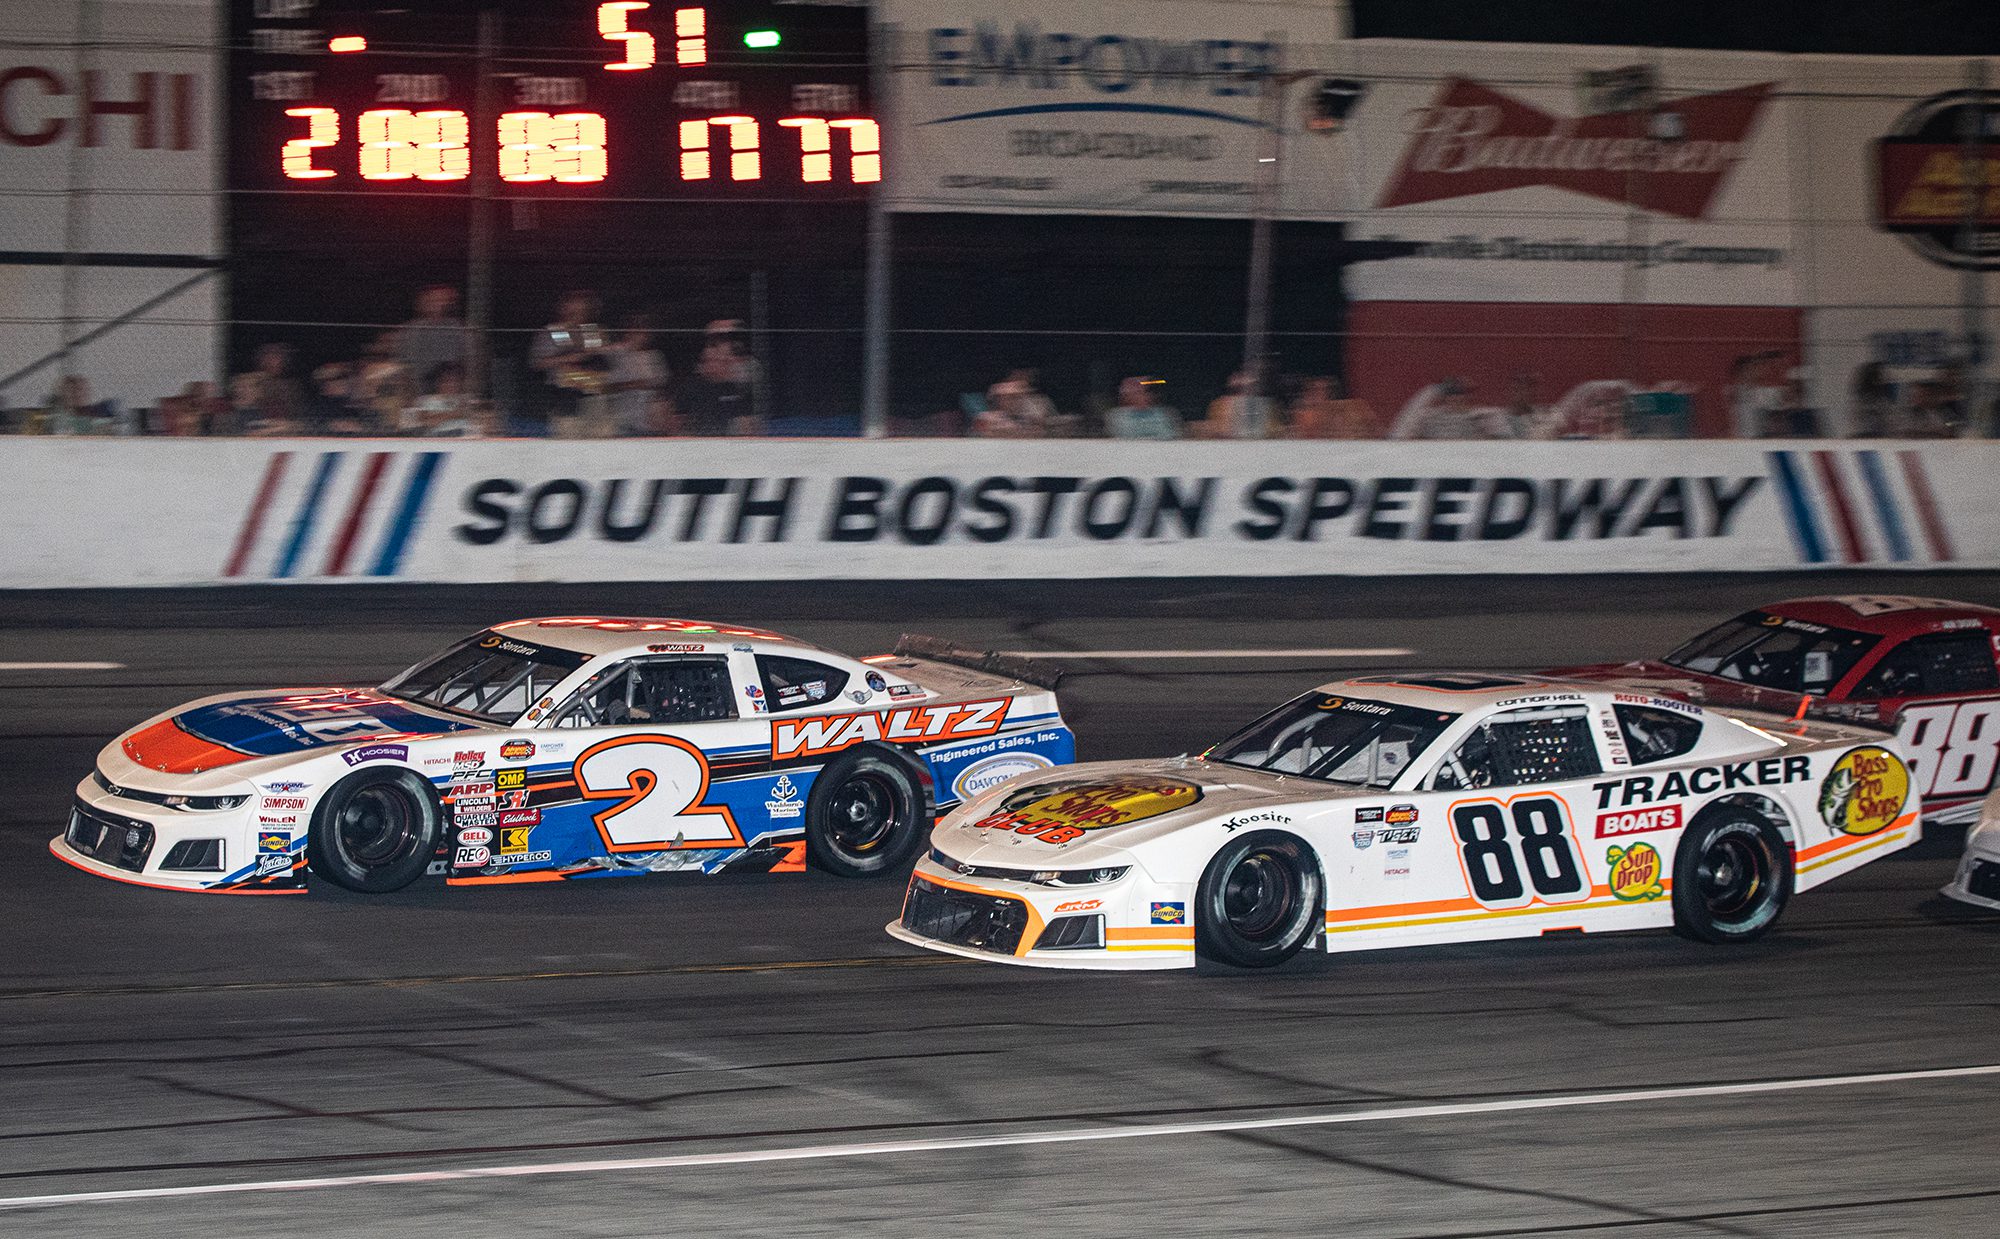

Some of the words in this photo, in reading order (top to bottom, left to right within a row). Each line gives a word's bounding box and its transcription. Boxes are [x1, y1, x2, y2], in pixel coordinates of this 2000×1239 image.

[281, 107, 340, 179] 2
[1407, 104, 1747, 173] Budweiser
[456, 477, 800, 544] SOUTH
[825, 476, 1216, 544] BOSTON
[1236, 475, 1765, 541] SPEEDWAY
[499, 641, 536, 655] Sentara
[1496, 695, 1550, 706] CONNOR
[1342, 701, 1391, 715] Sentara
[771, 696, 1013, 760] WALTZ
[361, 748, 405, 757] HOOSIER
[930, 741, 995, 763] Engineered
[998, 734, 1035, 750] Sales,
[1037, 732, 1060, 743] Inc.
[1896, 700, 2000, 796] 88
[454, 751, 486, 763] Holley
[454, 761, 483, 770] MSD
[1853, 754, 1888, 778] Bass
[451, 769, 493, 780] PFC
[498, 774, 524, 786] OMP
[1593, 755, 1810, 808] TRACKER
[450, 783, 494, 796] ARP
[575, 734, 748, 852] 2
[1855, 777, 1882, 799] Pro
[264, 798, 305, 809] SIMPSON
[457, 797, 489, 806] LINCOLN
[1855, 796, 1899, 821] Shops
[259, 815, 296, 823] WHELEN
[455, 813, 494, 824] QUARTER
[462, 819, 497, 827] MASTER
[503, 811, 538, 824] Edelbrock
[1221, 811, 1291, 833] Hoosier
[1603, 808, 1677, 835] BOATS
[973, 812, 1087, 844] CLUB
[260, 839, 290, 847] SUNOCO
[463, 832, 487, 840] BELL
[1452, 797, 1583, 902] 88
[503, 852, 549, 863] HYPERCO
[1621, 848, 1655, 870] Sun
[256, 855, 292, 876] Jostens
[1615, 865, 1652, 891] Drop
[1057, 901, 1101, 911] JRM
[1151, 909, 1184, 919] SUNOCO
